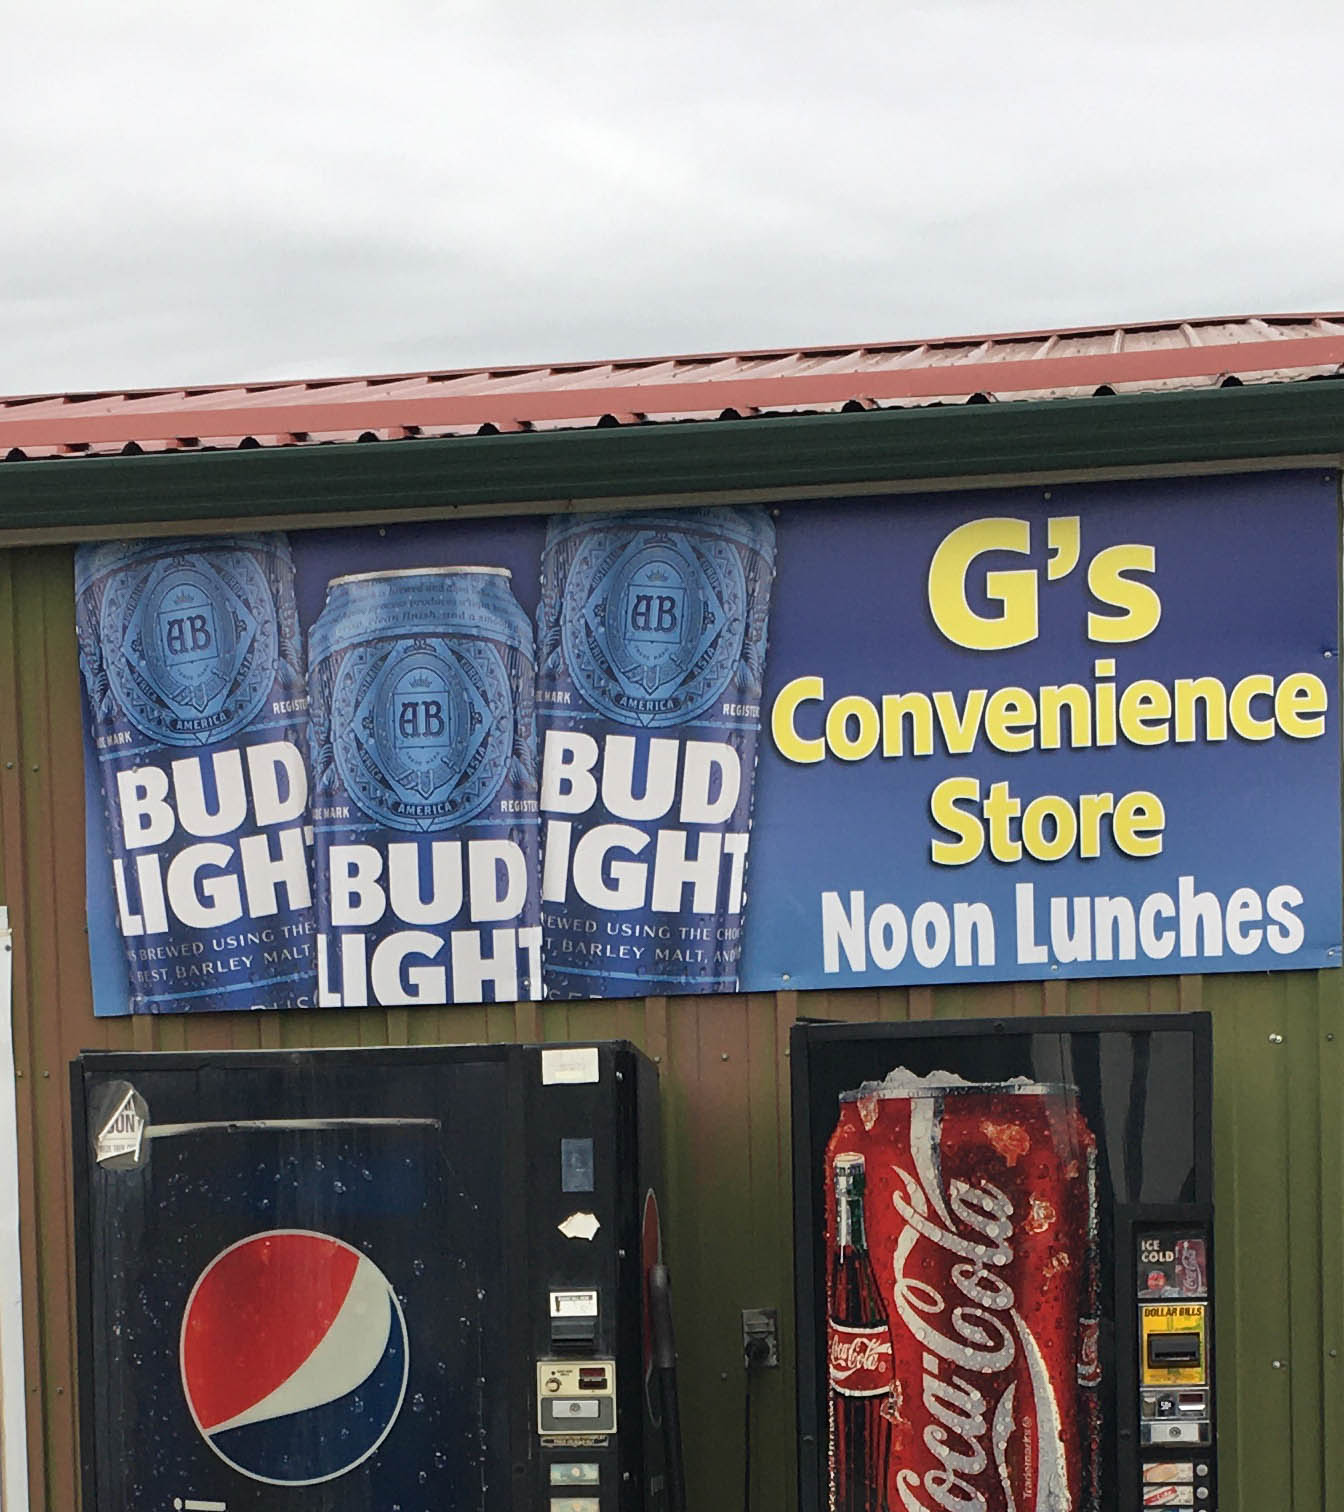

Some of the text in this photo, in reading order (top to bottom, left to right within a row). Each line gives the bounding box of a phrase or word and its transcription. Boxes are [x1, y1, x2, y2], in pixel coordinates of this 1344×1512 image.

[928, 516, 1162, 651] G's
[631, 594, 677, 632] AB
[167, 613, 212, 656] AB
[176, 712, 228, 730] AMERICA
[399, 701, 446, 738] AB
[619, 699, 674, 711] AMERICA
[771, 659, 1329, 764] Convenience
[466, 747, 487, 776] ASIA
[542, 731, 741, 824] BUD
[117, 741, 308, 851] BUD
[398, 803, 453, 816] AMERICA
[930, 777, 1166, 866] Store
[330, 841, 527, 926] BUD
[542, 821, 748, 915] IGHT
[140, 922, 314, 962] BREWED USING THE
[607, 922, 670, 939] USING
[679, 926, 712, 941] THE
[822, 876, 1306, 974] Noon Lunches
[176, 955, 254, 979] BARLEY
[318, 927, 542, 1007] LIGHT
[562, 938, 645, 960] BARLEY
[1141, 1240, 1160, 1250] ICE
[1141, 1251, 1174, 1263] COLD
[1144, 1307, 1202, 1317] DOLLAR BILLS
